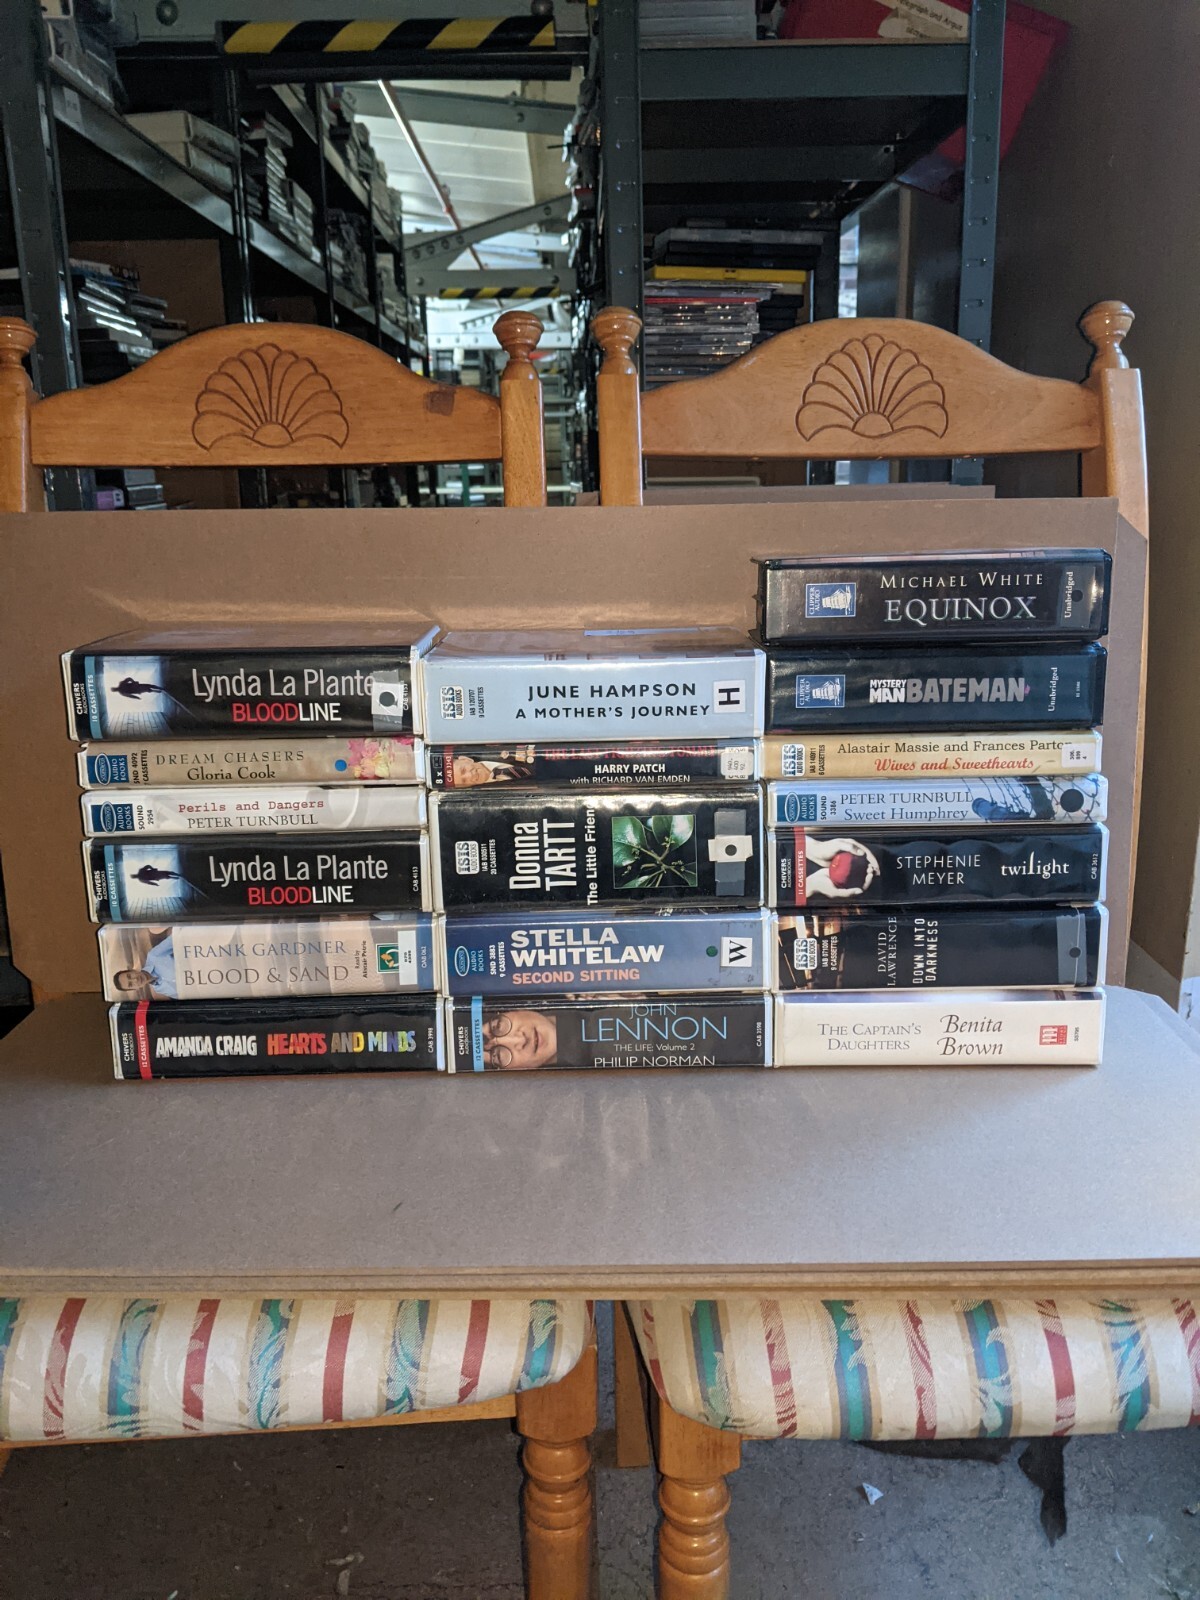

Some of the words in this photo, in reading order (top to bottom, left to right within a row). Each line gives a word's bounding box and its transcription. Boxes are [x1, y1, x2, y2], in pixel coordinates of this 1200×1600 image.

[881, 574, 967, 589] MICHAEL
[979, 572, 1043, 586] WHITE
[1065, 571, 1074, 618] Unabridged
[885, 596, 1036, 626] EQUINOX
[88, 675, 97, 714] CASSETTES
[192, 669, 261, 702] Lynda
[269, 670, 295, 696] La
[305, 670, 374, 696] Plante
[529, 685, 579, 700] JUNE
[591, 683, 696, 697] HAMPSON
[870, 679, 906, 688] MYSTERY
[907, 678, 1025, 702] BATEMAN
[1048, 667, 1058, 711] Unabridged
[73, 683, 83, 714] CHIVERS
[442, 687, 455, 718] ISIS
[719, 688, 740, 706] H
[870, 688, 905, 702] MAN
[516, 709, 526, 719] A
[535, 706, 623, 717] MOTHER'S
[632, 705, 710, 719] JOURNEY
[156, 752, 216, 765] DREAM
[224, 750, 304, 763] CHASERS
[837, 743, 890, 754] Alastair
[895, 742, 940, 752] Massie
[944, 741, 968, 752] and
[974, 741, 1025, 752] Frances
[594, 765, 629, 774] HARRY
[633, 764, 665, 773] PATCH
[783, 744, 796, 776] ISIS
[874, 758, 916, 771] Wives
[922, 758, 947, 771] and
[952, 758, 1034, 771] Sweethearts
[132, 770, 140, 783] SND
[187, 766, 232, 780] Gloria
[237, 765, 275, 779] Cook
[570, 775, 589, 784] with
[592, 775, 632, 783] RICHARD
[635, 775, 655, 783] VAN
[179, 802, 226, 813] Perils
[236, 802, 260, 811] and
[268, 800, 324, 812] Dangers
[841, 793, 885, 804] PETER
[890, 792, 973, 803] TURNBULL
[187, 816, 232, 830] PETER
[236, 814, 318, 827] TURNBULL
[845, 808, 885, 821] Sweet
[891, 808, 969, 821] Humphrey
[458, 842, 470, 873] ISIS
[509, 822, 541, 889] Donna
[543, 819, 577, 891] TARTT
[586, 846, 597, 878] Little
[897, 854, 981, 869] STEPHENIE
[1002, 852, 1069, 880] twilight
[108, 863, 116, 899] CASSETTES
[209, 856, 276, 886] Lynda
[284, 855, 309, 880] La
[318, 854, 388, 879] Plante
[913, 872, 964, 885] MEYER
[94, 871, 103, 900] CHIVERS
[587, 882, 598, 905] The
[511, 927, 618, 949] STELLA
[915, 918, 925, 950] INTO
[184, 944, 246, 959] FRANK
[252, 941, 346, 957] GARDNER
[512, 945, 664, 967] WHITELAW
[729, 941, 747, 963] W
[796, 939, 808, 968] ISIS
[878, 932, 886, 972] DAVID
[888, 917, 897, 986] LAWRENCE
[926, 920, 938, 981] DARKNESS
[184, 968, 260, 985] BLOOD
[267, 968, 284, 983] &
[289, 965, 348, 982] SAND
[512, 971, 574, 984] SECOND
[580, 969, 640, 981] SITTING
[913, 954, 923, 984] DOWN
[629, 1004, 677, 1019] JOHN
[582, 1016, 726, 1041] LENNON
[818, 1024, 848, 1035] THE
[853, 1023, 921, 1035] CAPTAIN'S
[940, 1015, 1002, 1033] Benita
[122, 1033, 130, 1061] CHIVERS
[156, 1036, 213, 1058] AMANDA
[216, 1035, 256, 1056] CRAIG
[267, 1032, 326, 1055] HEARTS
[331, 1032, 364, 1054] AND
[368, 1031, 417, 1053] MINDS
[635, 1043, 653, 1051] LIFE:
[656, 1043, 687, 1051] Volume
[828, 1038, 910, 1050] DAUGHTERS
[937, 1037, 1002, 1056] Brown
[595, 1056, 637, 1067] PHILIP
[643, 1056, 715, 1066] NORMAN
